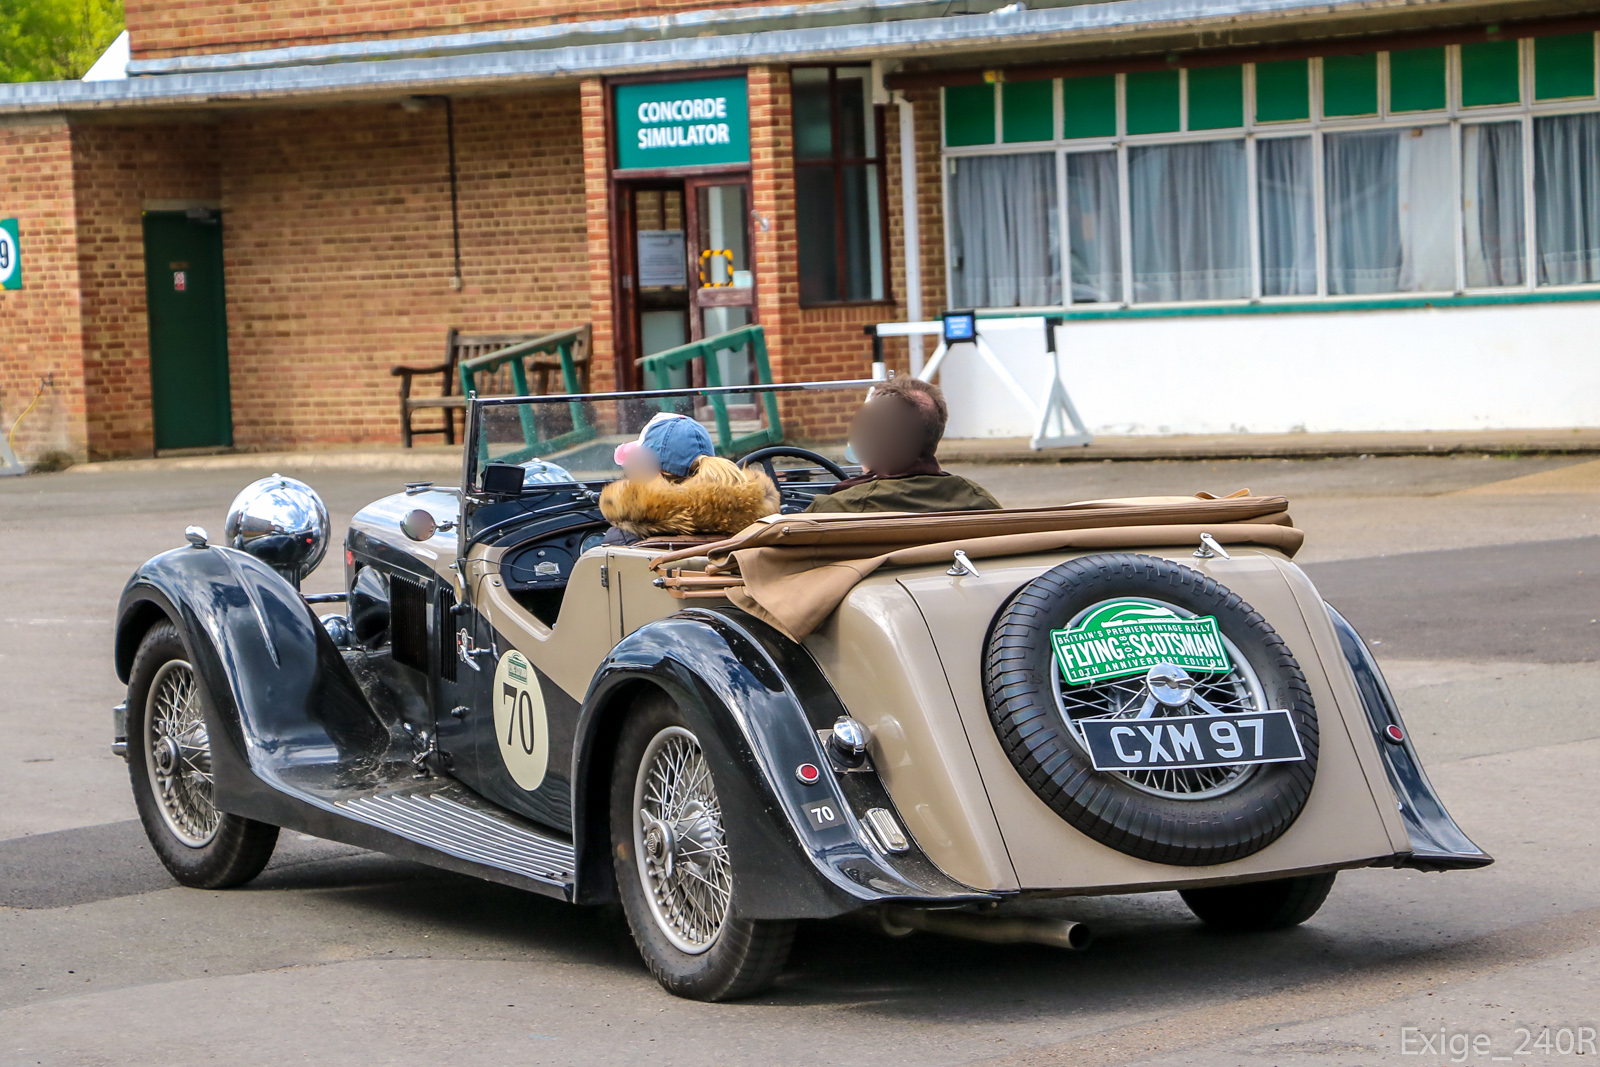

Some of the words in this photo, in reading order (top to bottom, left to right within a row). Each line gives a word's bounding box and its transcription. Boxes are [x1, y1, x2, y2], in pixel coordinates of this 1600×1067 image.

[638, 97, 727, 123] CONCORDE
[638, 123, 730, 149] SIMULATOR
[1057, 630, 1104, 644] BRITAIN'S
[1106, 625, 1146, 636] PREMIER
[1148, 624, 1183, 632] VINTAGE
[1184, 624, 1211, 633] RALLY
[1119, 635, 1136, 658] 2018
[1061, 637, 1126, 669] FLYING
[1128, 632, 1220, 657] SCOTSMAN
[1071, 666, 1100, 678] 10TH
[1105, 657, 1179, 672] ANNIVERSARY
[1184, 657, 1223, 667] EDITION
[502, 682, 534, 755] 70
[1109, 723, 1205, 763] CXM
[1209, 718, 1264, 759] 97
[811, 806, 835, 824] 70
